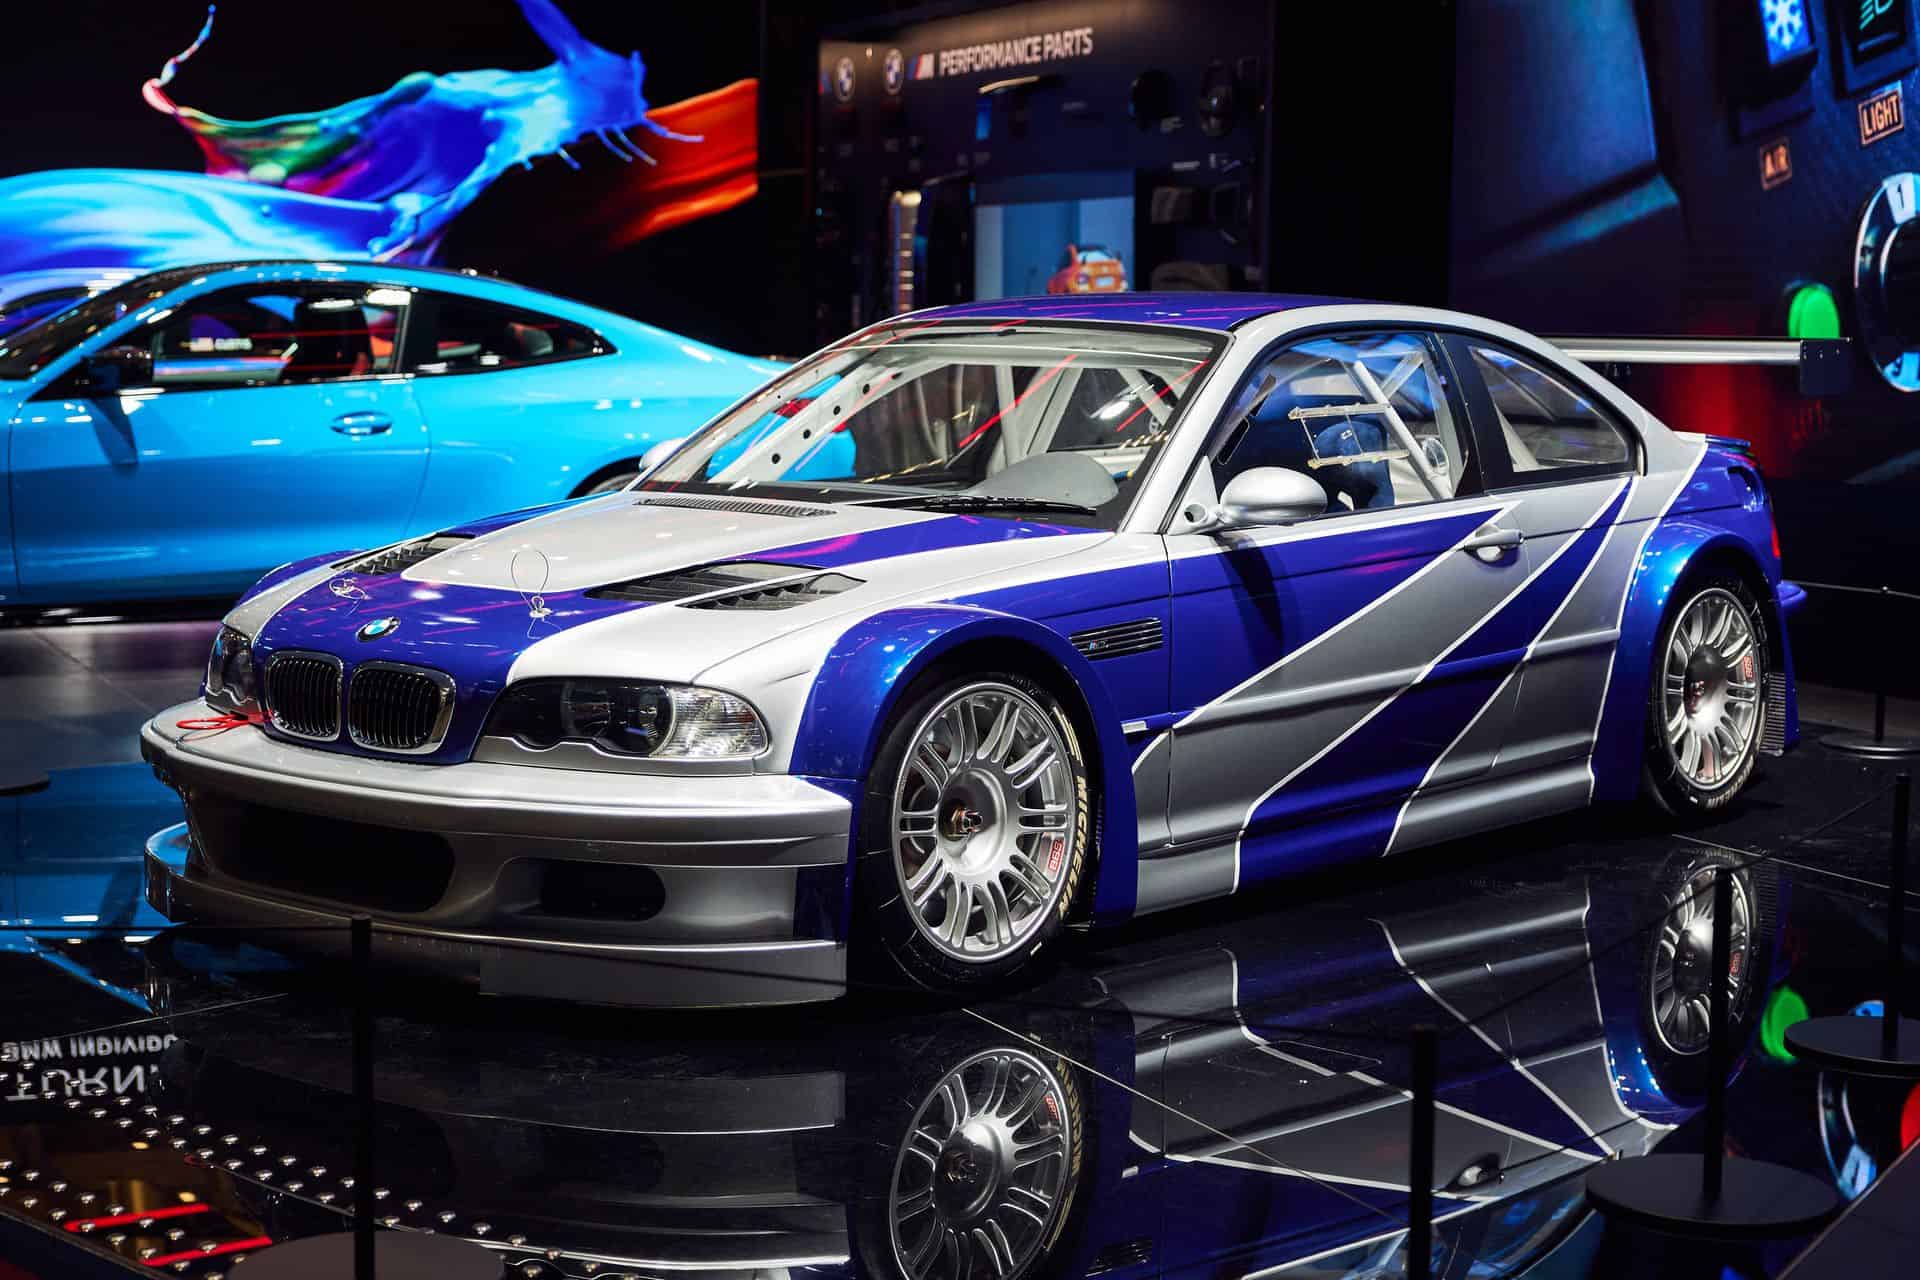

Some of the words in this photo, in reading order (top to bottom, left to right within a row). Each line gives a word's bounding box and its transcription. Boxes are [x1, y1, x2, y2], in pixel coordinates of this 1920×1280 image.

[940, 38, 1042, 76] PERFORMANCE
[1043, 27, 1094, 60] PARTS
[1863, 95, 1898, 136] LIGHT
[1049, 839, 1064, 872] BBS
[1059, 775, 1088, 920] MICHELIN
